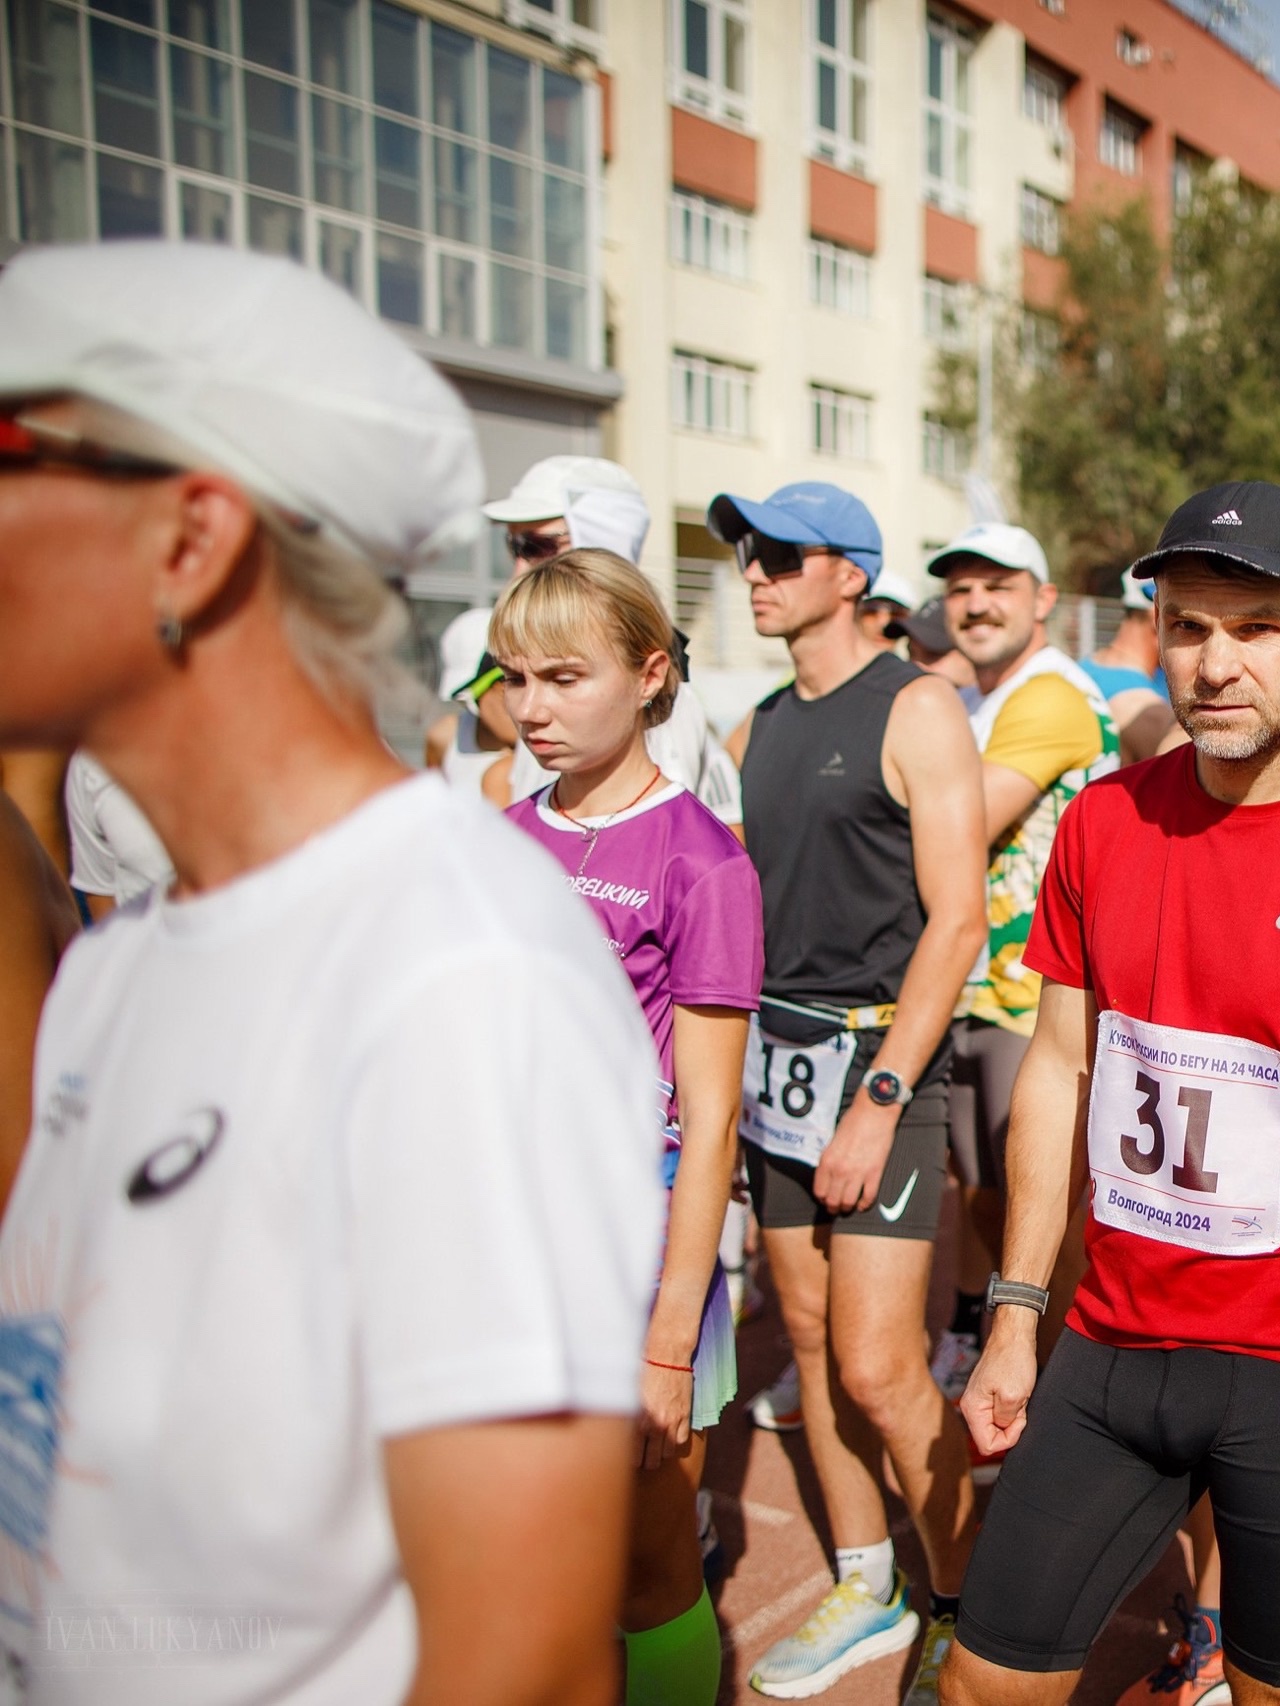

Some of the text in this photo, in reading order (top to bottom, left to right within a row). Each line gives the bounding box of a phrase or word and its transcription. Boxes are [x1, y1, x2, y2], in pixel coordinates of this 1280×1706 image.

[1211, 517, 1243, 526] adidas
[758, 1043, 815, 1118] 18
[1108, 1029, 1137, 1050] КУБОК
[1160, 1050, 1178, 1066] ПО
[1180, 1053, 1210, 1070] БЕГУ
[1211, 1056, 1229, 1074] НА
[1230, 1061, 1246, 1077] 24
[1247, 1064, 1280, 1083] ЧАСА
[1119, 1070, 1219, 1194] 31
[1107, 1188, 1211, 1232] Волгоград 2024
